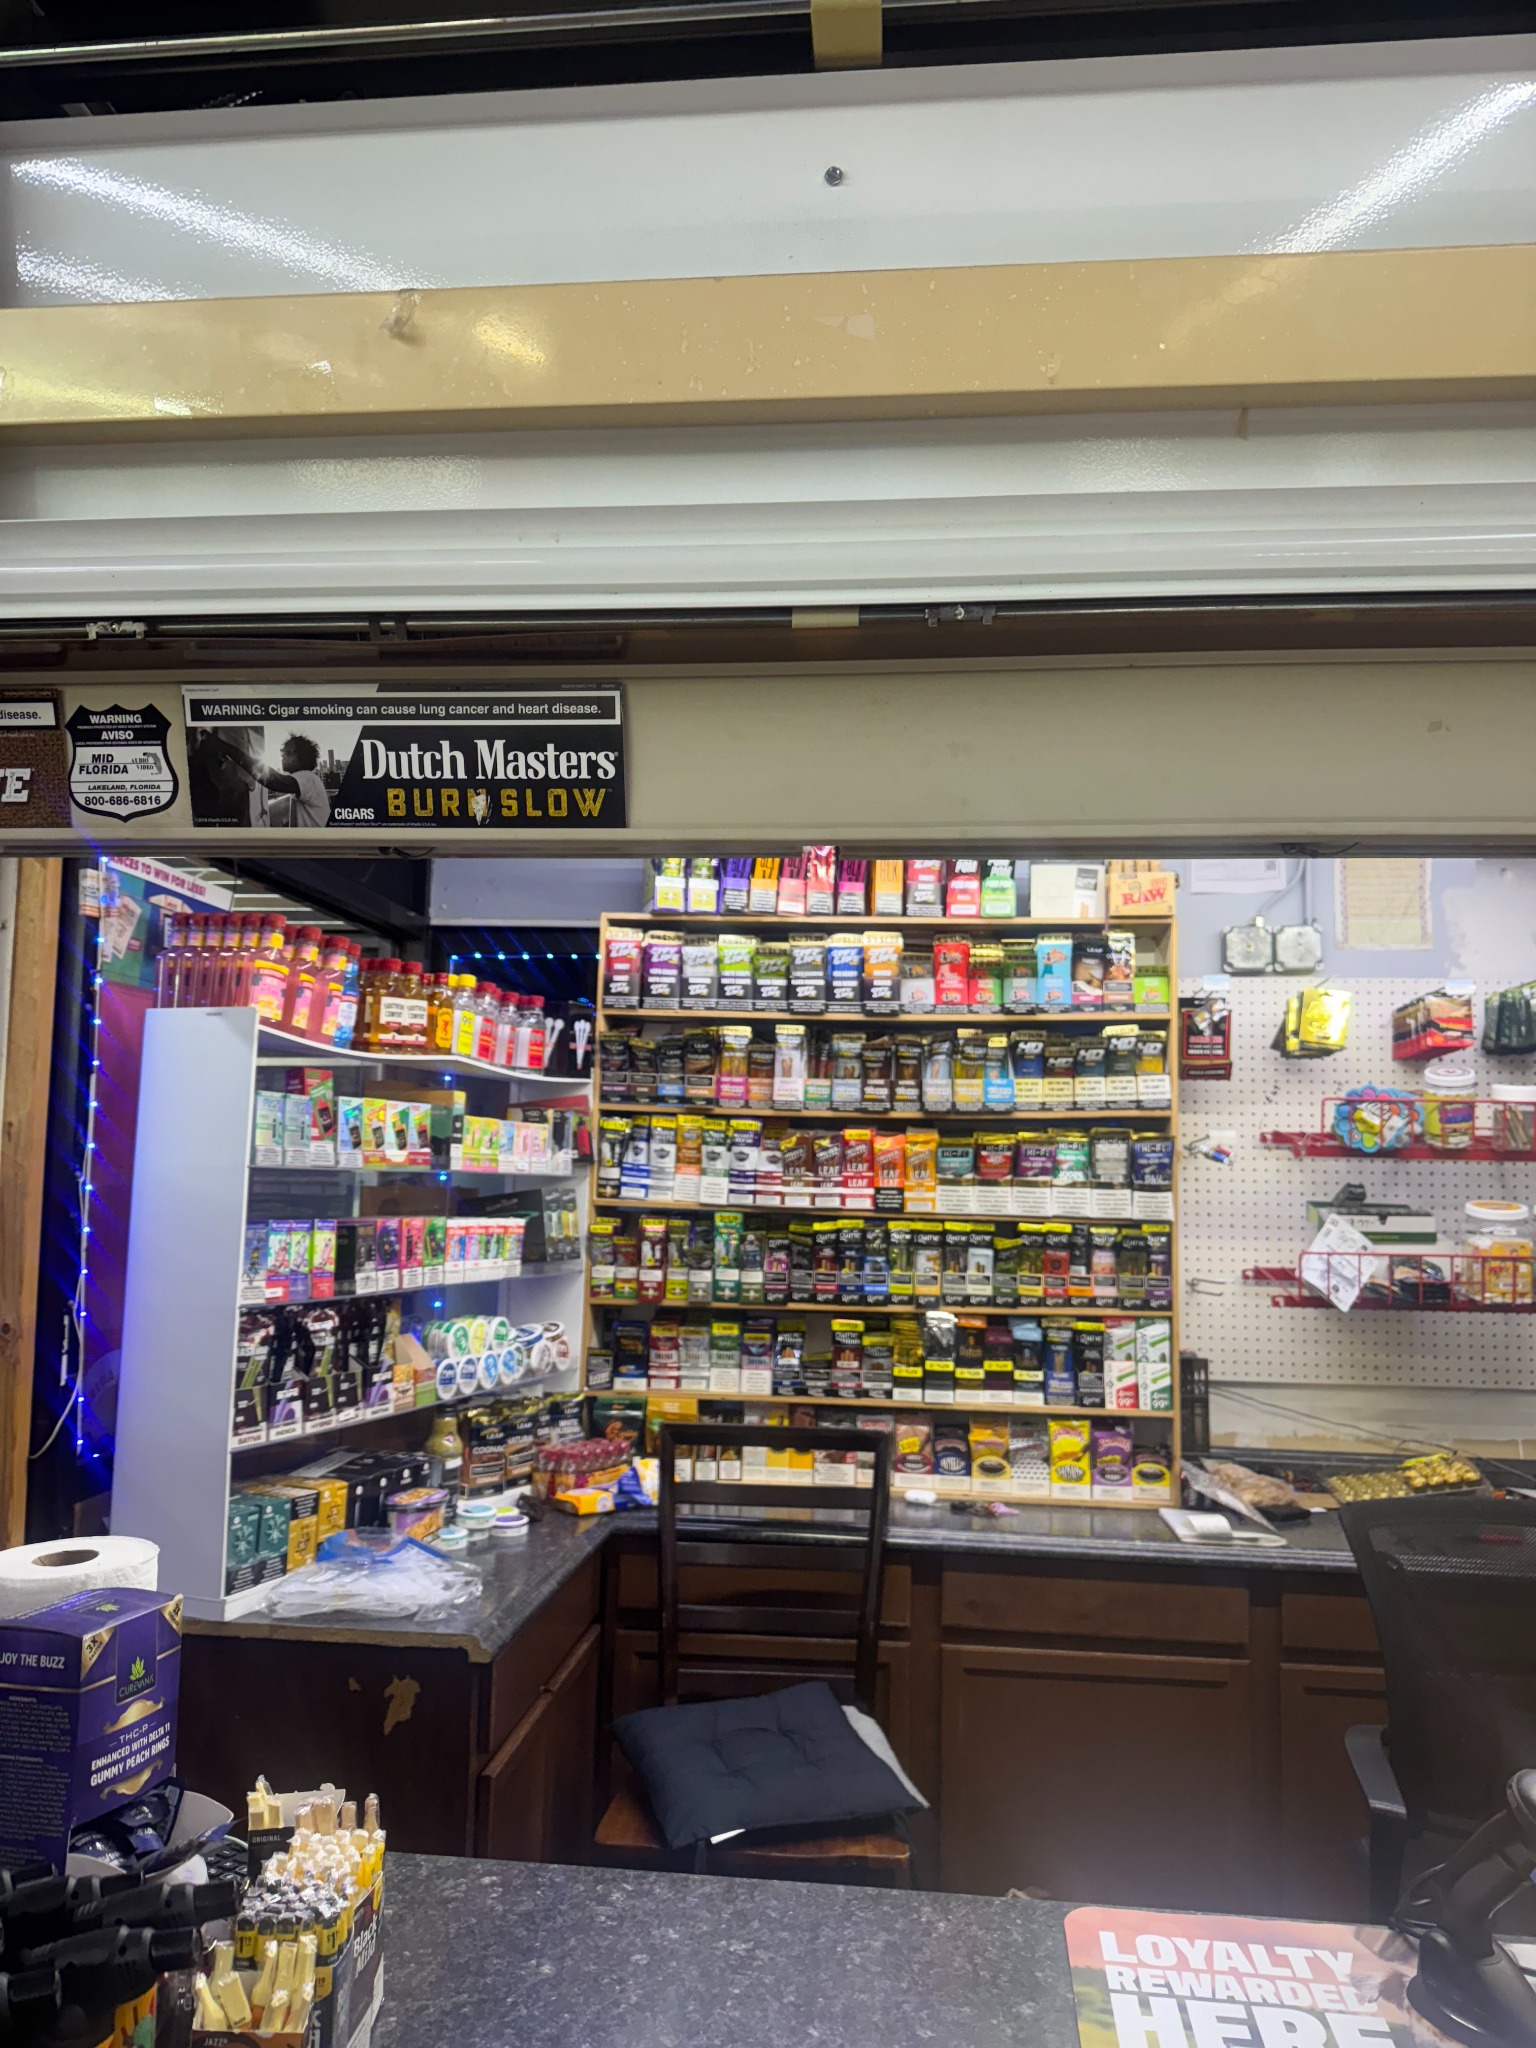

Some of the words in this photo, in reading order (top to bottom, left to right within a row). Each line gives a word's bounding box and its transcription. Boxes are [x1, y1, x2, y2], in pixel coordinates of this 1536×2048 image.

[201, 704, 265, 716] WARNING:
[269, 703, 300, 718] Cigar
[302, 703, 353, 718] smoking
[356, 706, 378, 715] can
[381, 705, 416, 715] cause
[419, 703, 446, 717] lung
[449, 705, 489, 715] cancer
[492, 703, 515, 714] and
[518, 703, 549, 714] heart
[551, 702, 601, 714] disease.
[89, 714, 142, 724] WARNING
[101, 730, 134, 740] AVISO
[91, 753, 114, 764] MID
[360, 739, 468, 780] Dutch
[473, 739, 616, 780] Masters
[78, 765, 129, 775] FLORIDA
[84, 795, 161, 806] 800-686-6816
[387, 788, 488, 817] BURN
[500, 788, 607, 817] SLOW
[334, 808, 375, 820] CIGARS
[1121, 887, 1166, 906] RAW
[785, 1167, 805, 1176] LEAF
[818, 1165, 841, 1175] LEAF
[846, 1163, 869, 1172] LEAF
[878, 1169, 900, 1179] LEAF
[909, 1169, 932, 1180] LEAF
[847, 1179, 869, 1188] LEAF
[20, 1653, 38, 1667] THE
[40, 1655, 65, 1669] BUZZ
[118, 1673, 154, 1698] CUREVANA
[119, 1723, 149, 1744] THC-P
[91, 1745, 131, 1771] ENHANCED
[131, 1736, 148, 1752] WITH
[148, 1725, 165, 1743] DELTA
[90, 1761, 124, 1787] GUMMY
[126, 1747, 150, 1771] PEACH
[151, 1735, 170, 1757] RINGS
[251, 1834, 281, 1844] ORIGINAL
[353, 1913, 378, 1958] Black
[1098, 1930, 1354, 1984] LOYALTY
